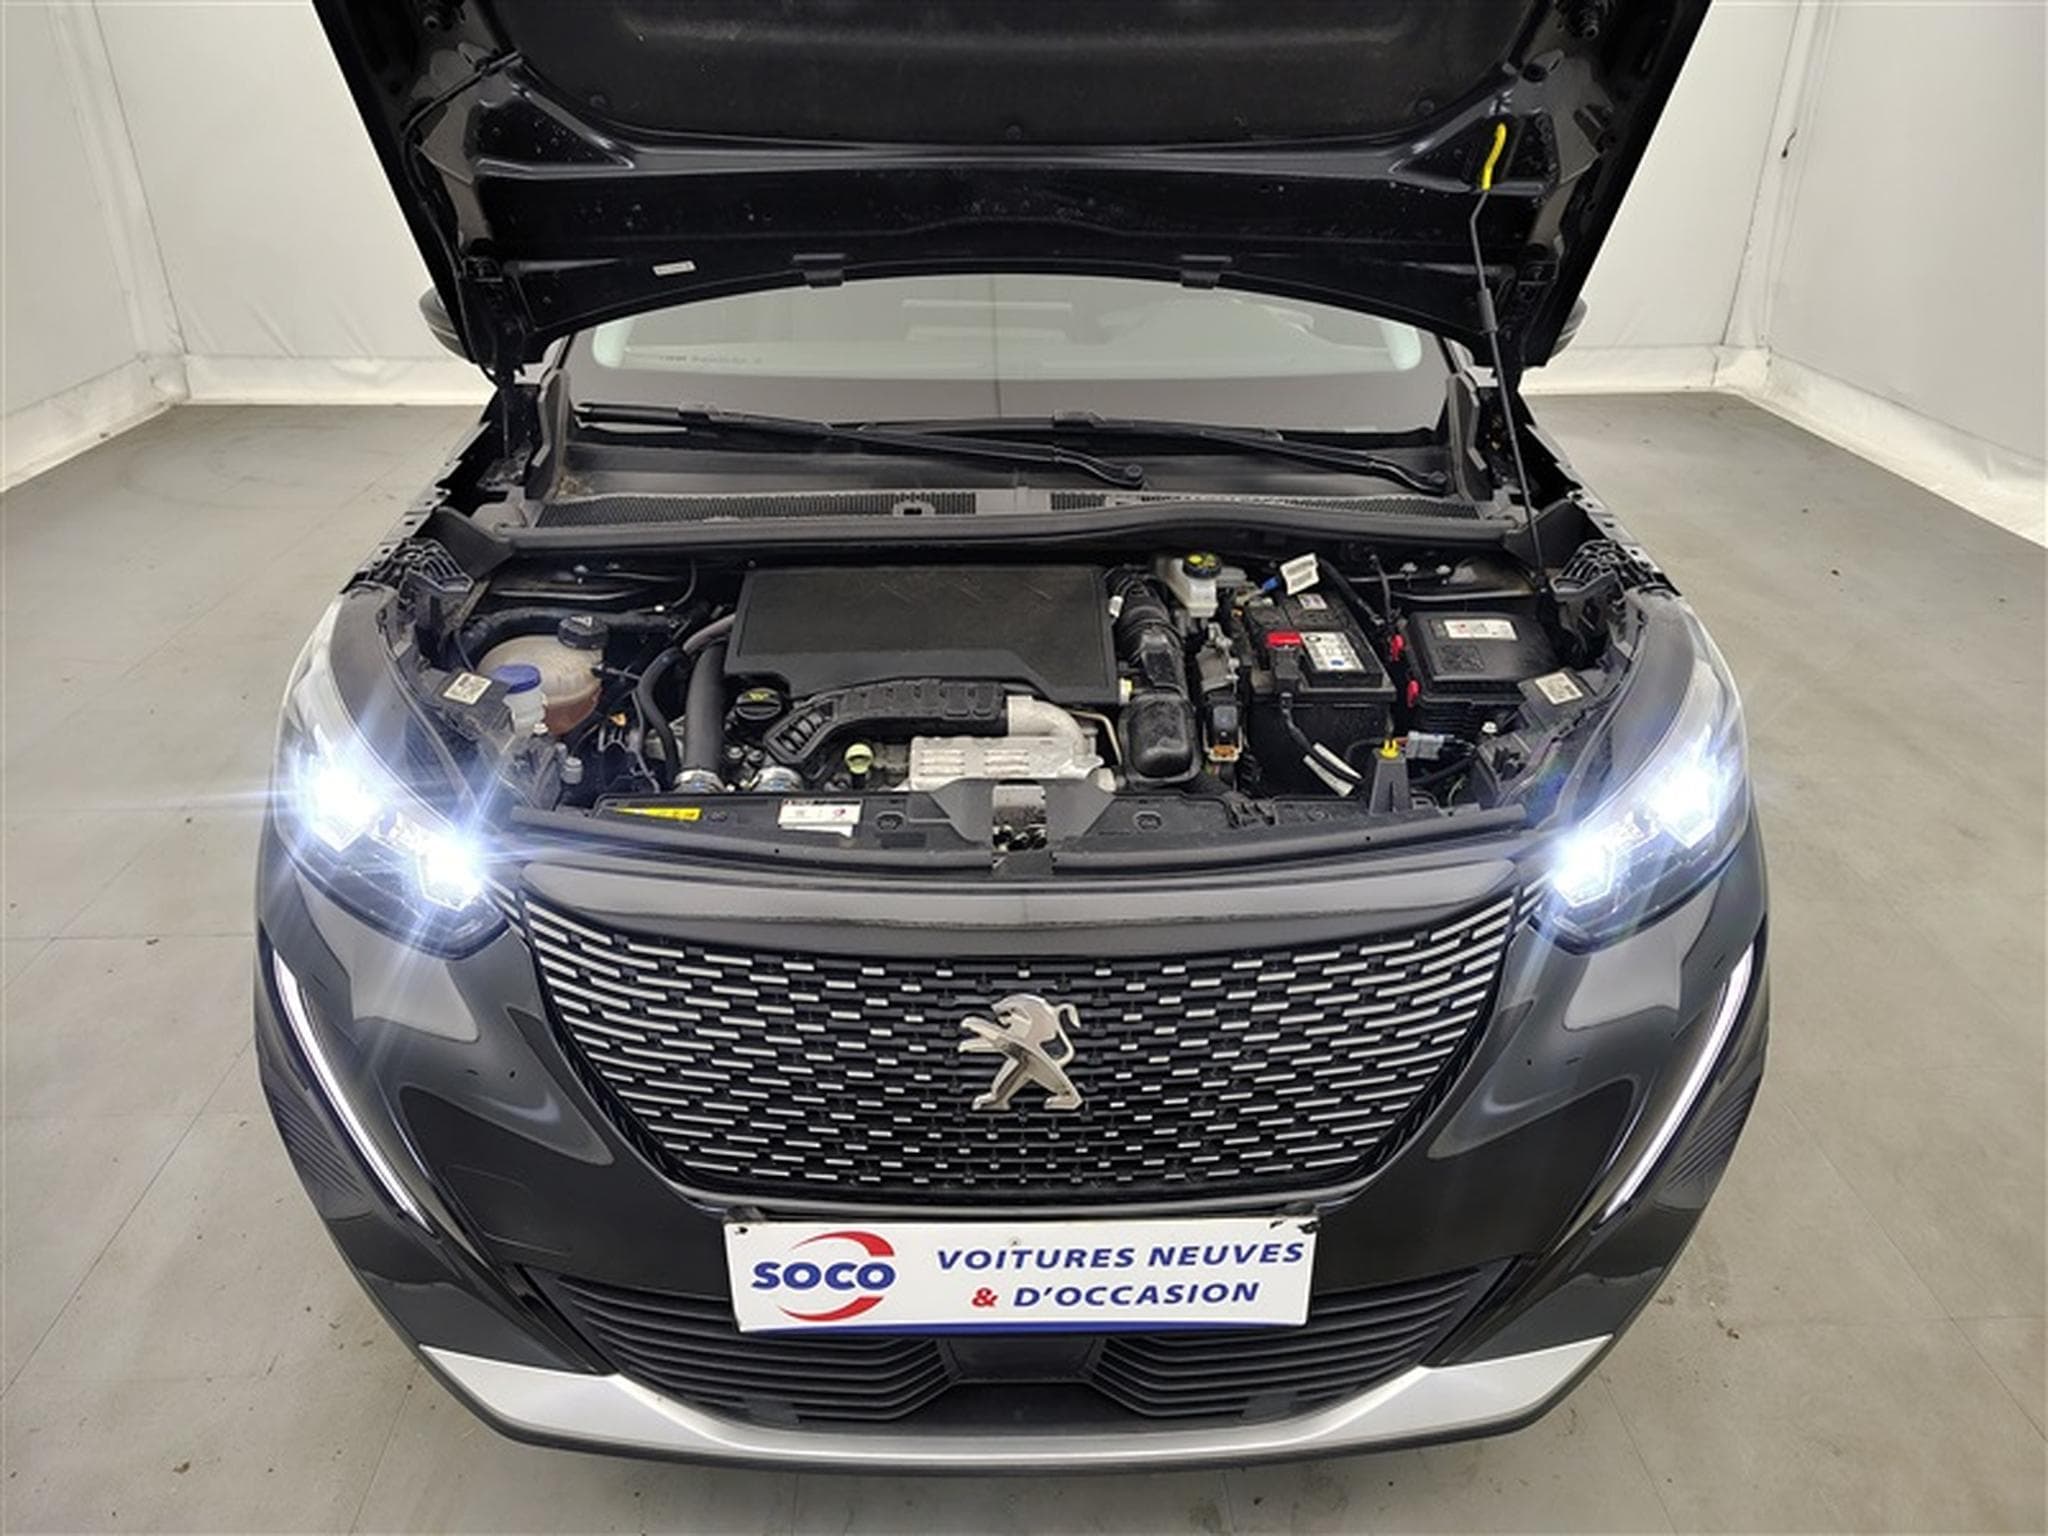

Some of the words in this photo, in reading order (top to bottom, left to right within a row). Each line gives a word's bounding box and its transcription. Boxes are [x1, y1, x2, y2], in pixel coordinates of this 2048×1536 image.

[937, 1248, 1135, 1270] VOITURES
[1147, 1242, 1305, 1267] NEUVES
[751, 1261, 896, 1290] SOCO
[971, 1287, 998, 1307] &
[1012, 1281, 1260, 1307] D'OCCASION
